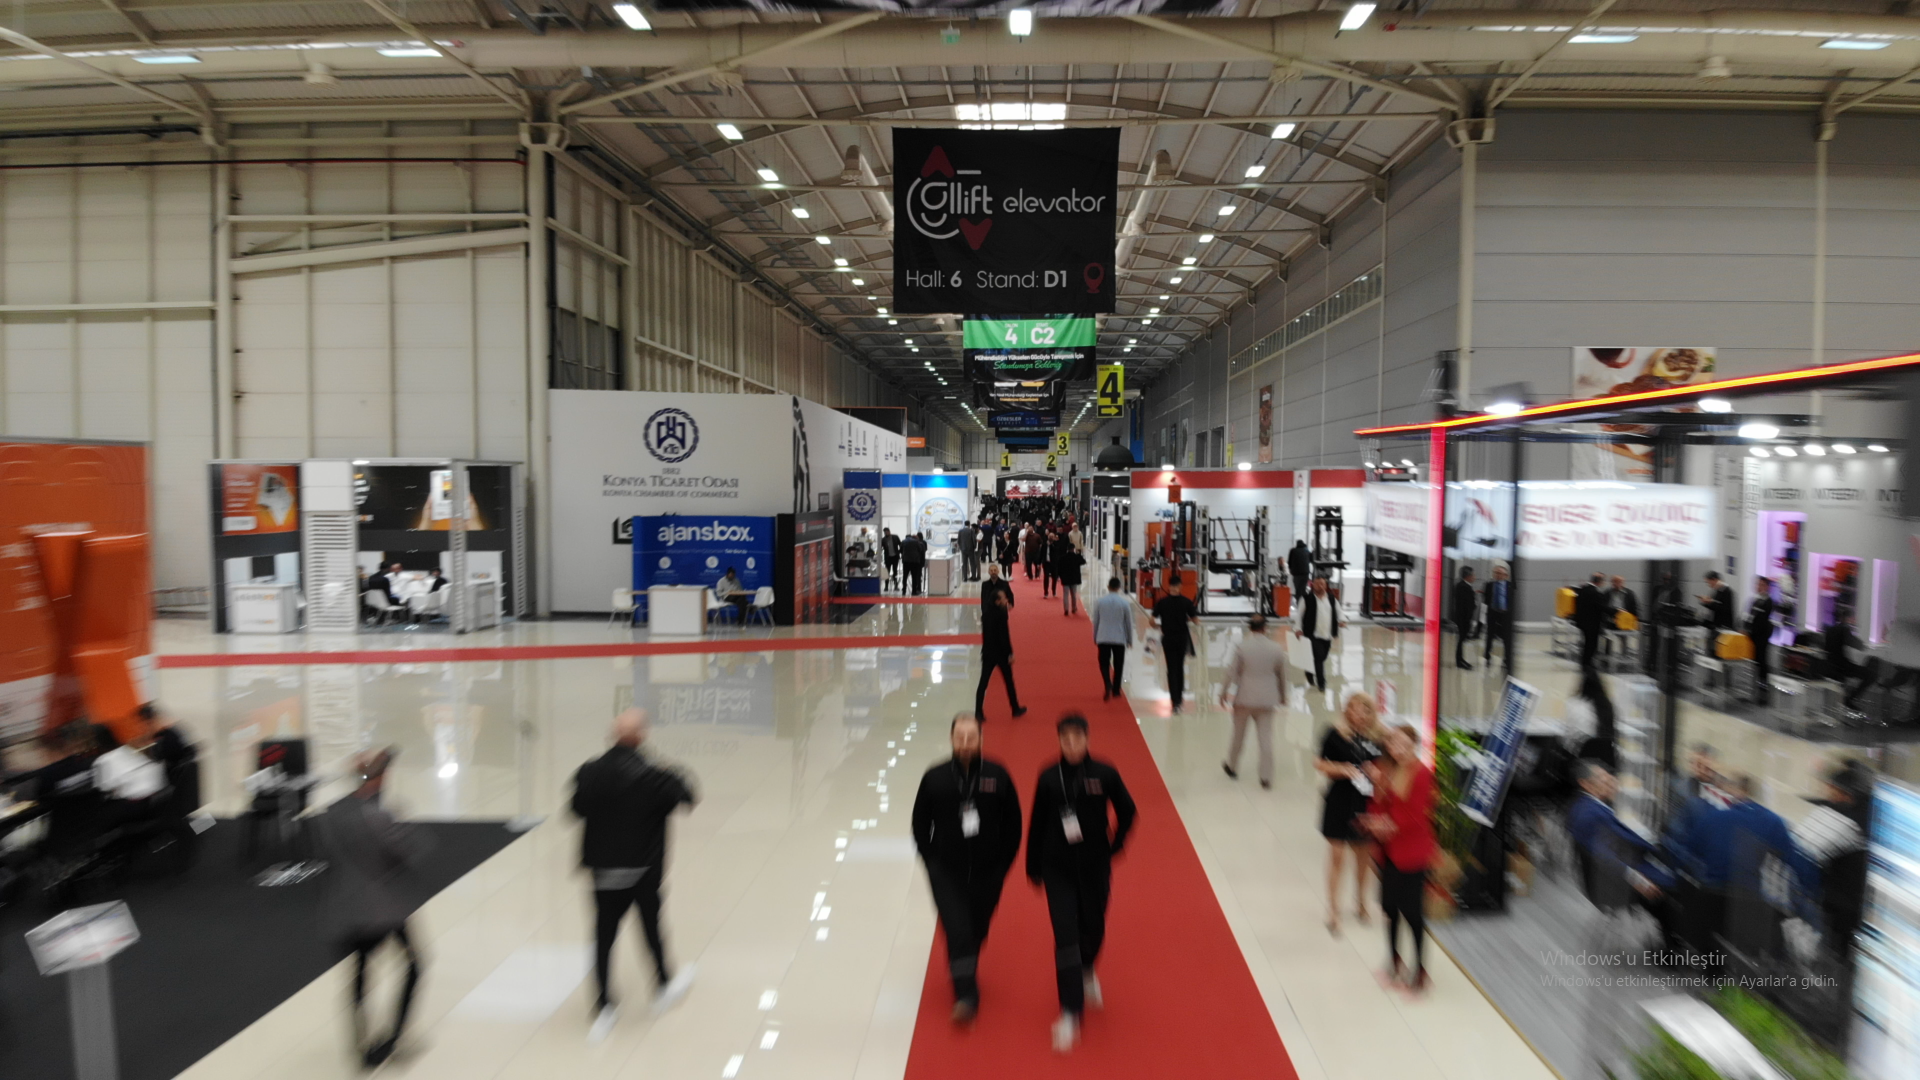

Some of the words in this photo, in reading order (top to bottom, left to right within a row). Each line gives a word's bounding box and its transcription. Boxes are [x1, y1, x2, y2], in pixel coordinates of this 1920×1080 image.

[1003, 187, 1106, 213] elevator
[906, 270, 945, 288] Hall:
[950, 270, 962, 288] 6
[976, 270, 1039, 289] Stand:
[1044, 270, 1067, 288] D1
[1005, 328, 1018, 345] 4
[1030, 327, 1056, 345] C2
[1100, 372, 1121, 404] 4
[1058, 436, 1067, 450] 3
[1003, 454, 1009, 467] 1
[1048, 454, 1055, 467] 2
[602, 474, 647, 487] KONYA
